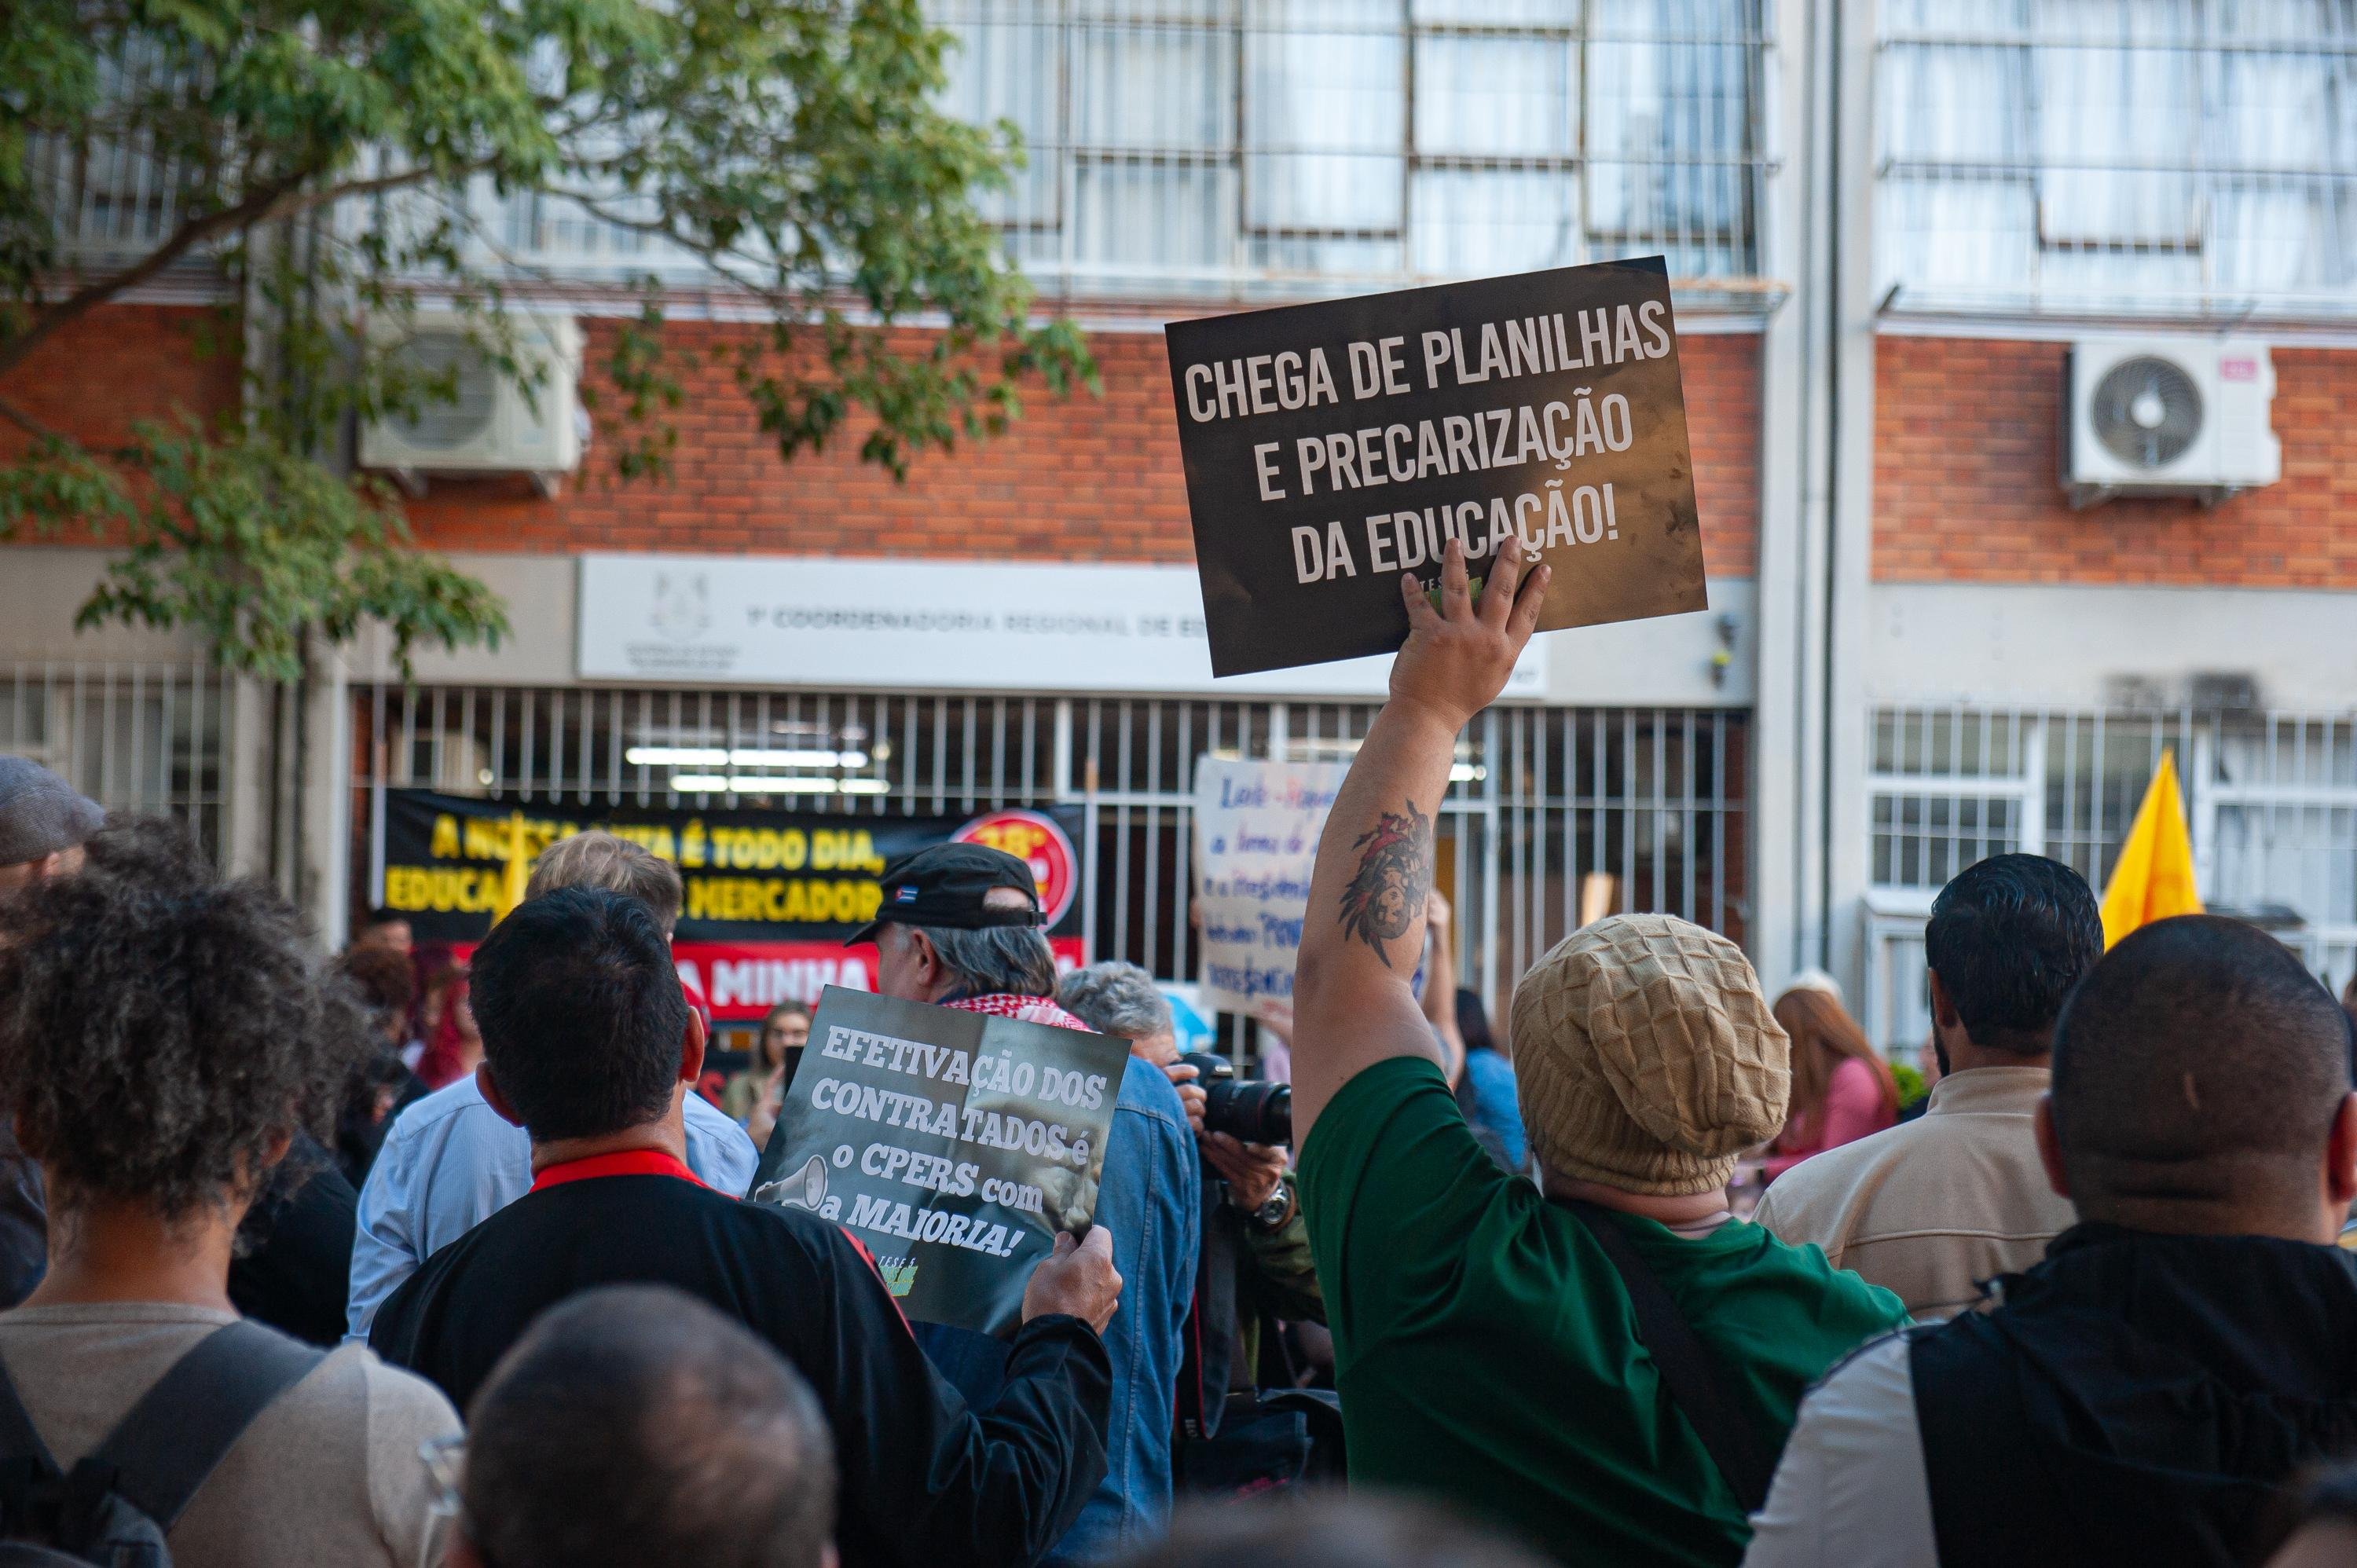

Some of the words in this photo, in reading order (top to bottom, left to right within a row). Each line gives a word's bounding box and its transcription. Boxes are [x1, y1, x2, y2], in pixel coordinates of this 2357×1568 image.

[1185, 347, 1339, 423] CHEGA
[1348, 335, 1410, 400] DE
[1421, 300, 1670, 389] PLANILHAS
[1254, 441, 1286, 501] E
[1296, 387, 1633, 495] PRECARIZAÇÃO
[1292, 520, 1357, 584] DA
[1365, 479, 1619, 573] EDUCAÇÃO!
[431, 812, 460, 859] A
[680, 817, 706, 867] É
[710, 826, 808, 870] TODO
[811, 826, 887, 877] DIA,
[385, 865, 507, 914] EDUCA
[688, 875, 884, 923] MERCADOR
[709, 958, 870, 1006] MINHA
[821, 1024, 1035, 1097] EFETIVAÇÃO
[1037, 1065, 1107, 1111] DOS
[811, 1077, 1069, 1161] CONTRATADOS
[1072, 1130, 1091, 1165] é
[832, 1145, 854, 1169] o
[860, 1141, 980, 1198] CPERS
[981, 1178, 1043, 1214] com
[819, 1194, 842, 1222] a
[845, 1193, 1026, 1258] MAIORIA!
